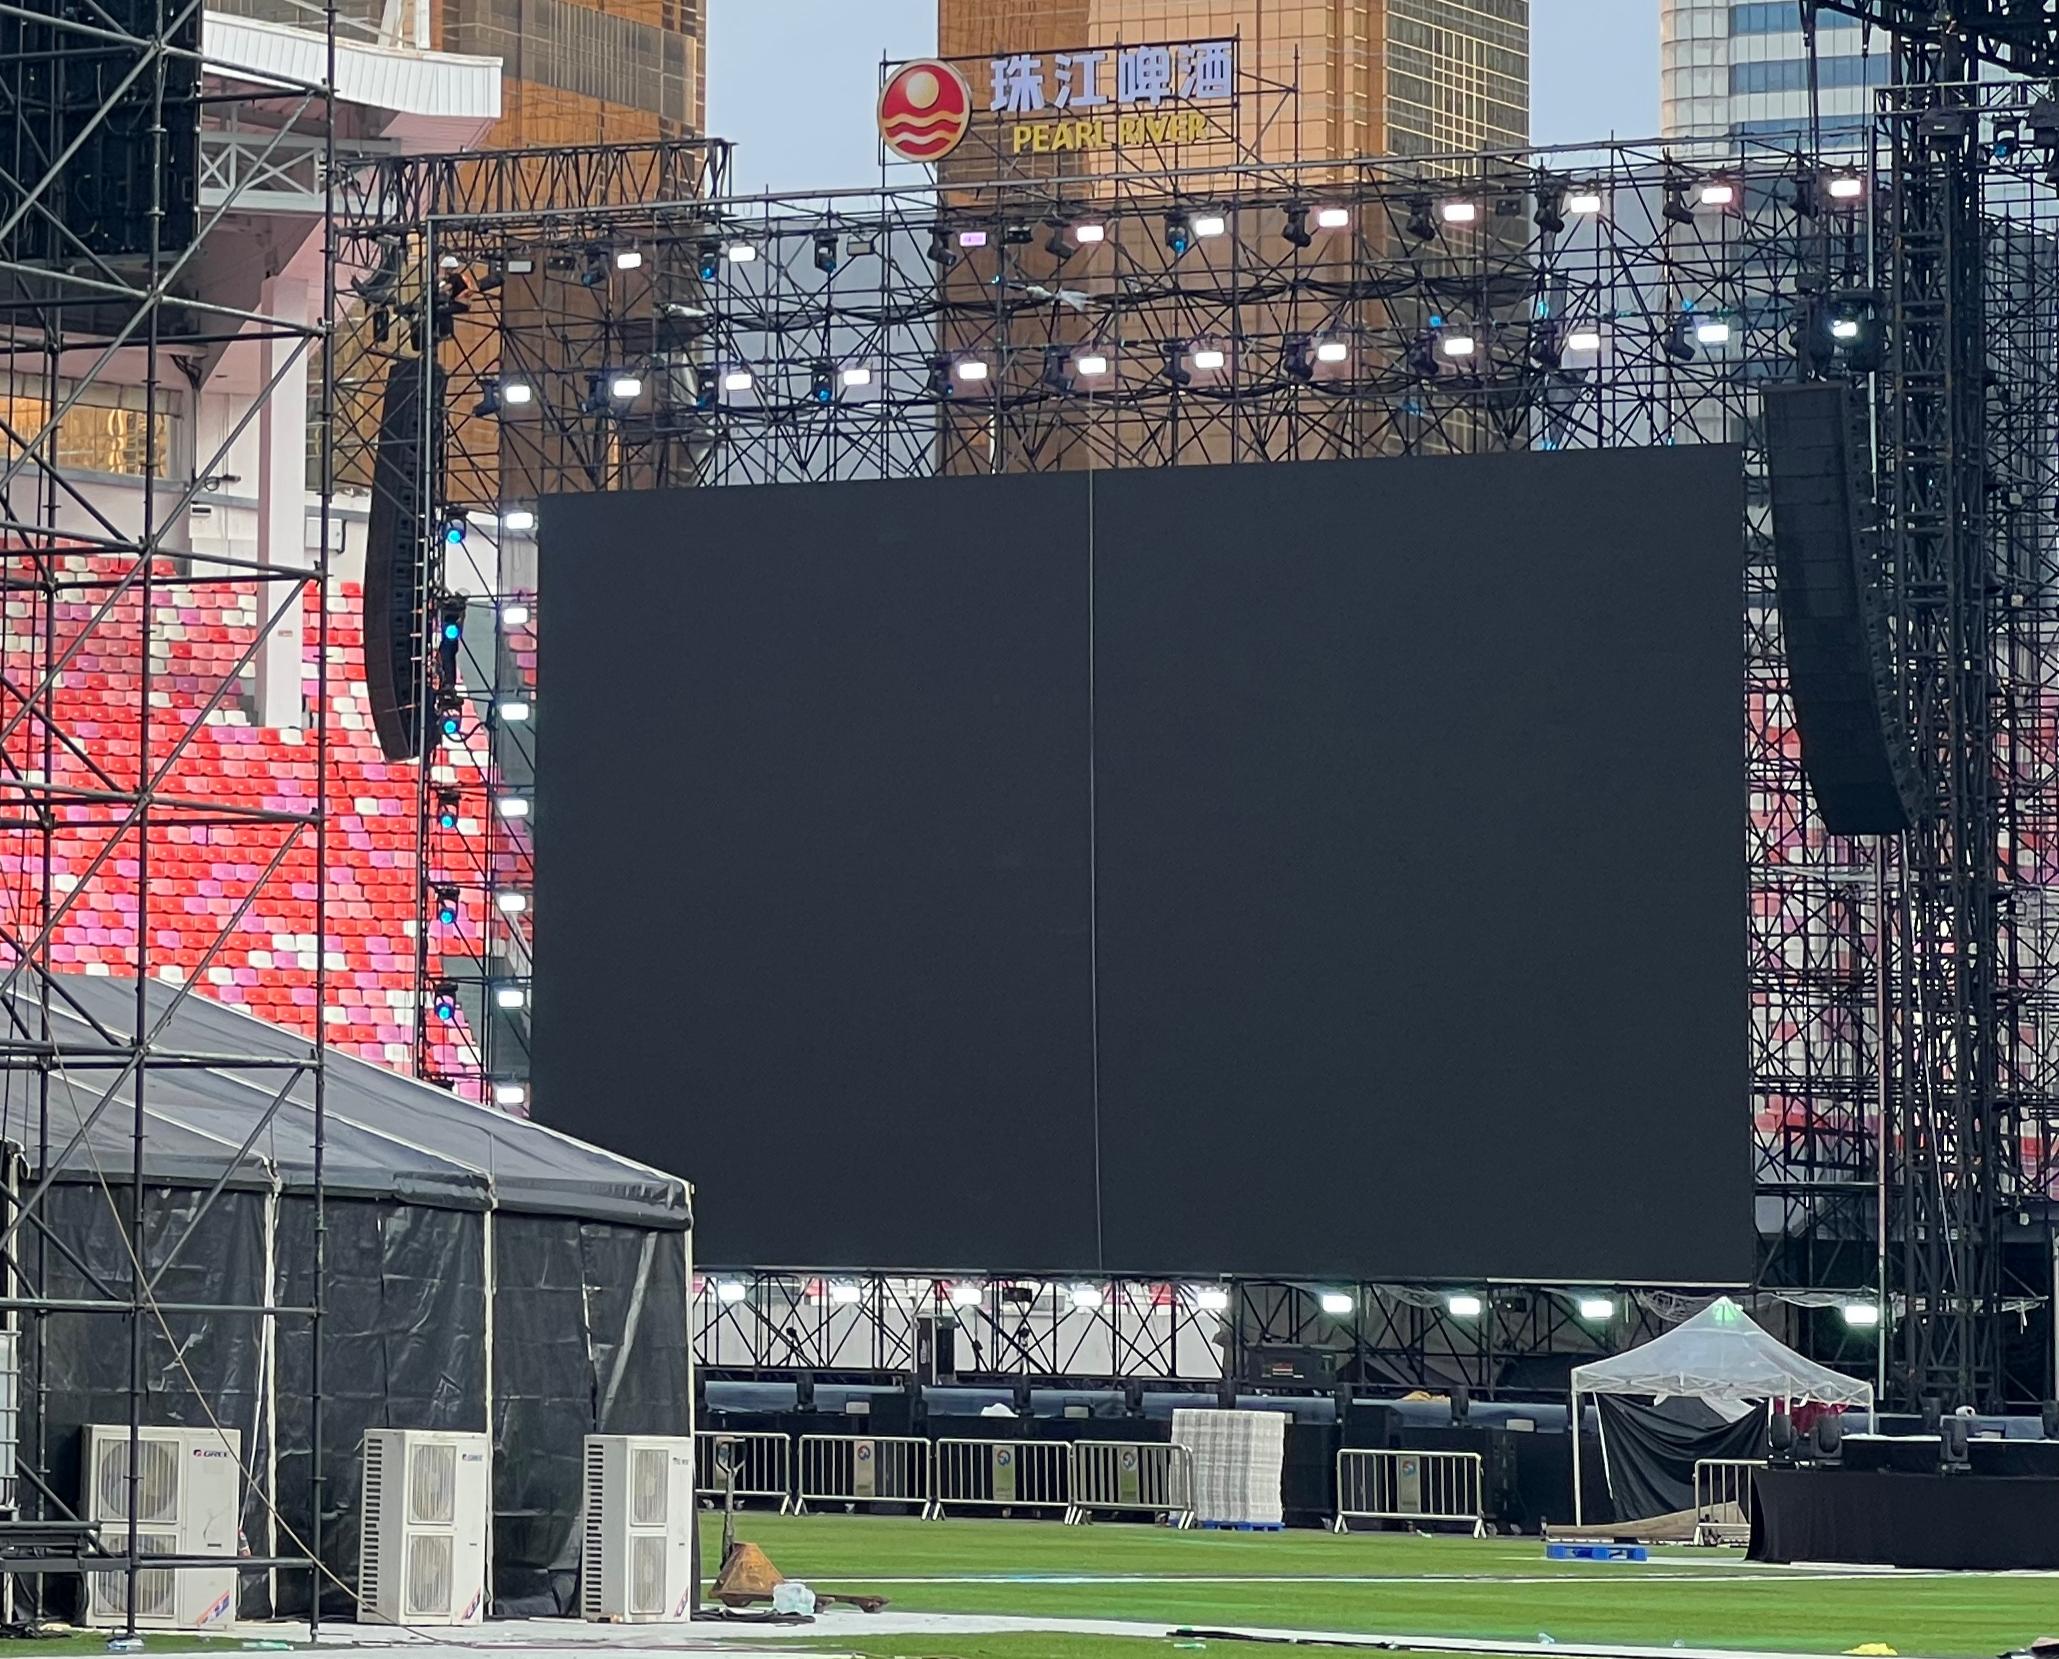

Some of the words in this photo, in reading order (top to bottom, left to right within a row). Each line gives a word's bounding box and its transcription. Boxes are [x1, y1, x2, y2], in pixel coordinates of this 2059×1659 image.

[991, 42, 1232, 112] 珠江啤酒
[1014, 120, 1112, 153] PEARL
[1119, 112, 1208, 146] RIVER
